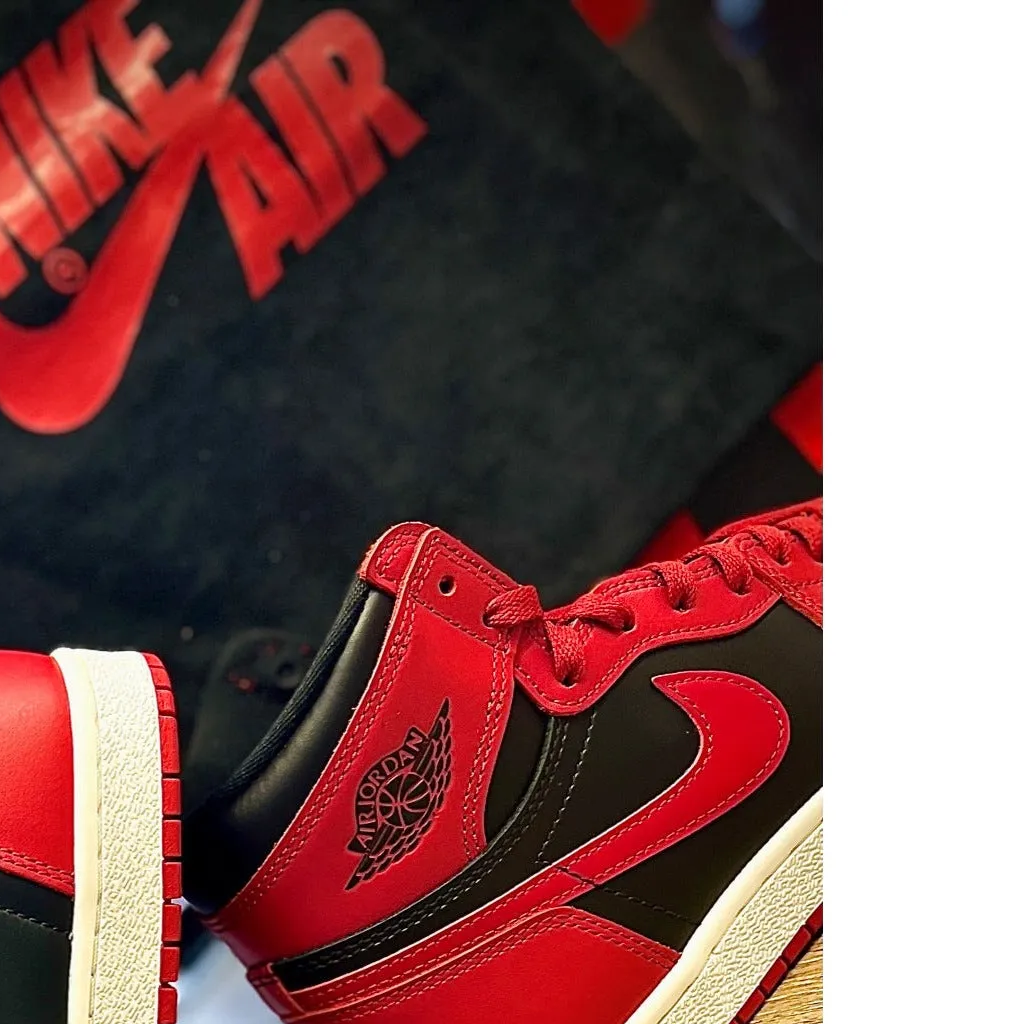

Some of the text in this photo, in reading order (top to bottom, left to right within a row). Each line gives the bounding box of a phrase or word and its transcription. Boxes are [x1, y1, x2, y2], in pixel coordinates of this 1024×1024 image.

[205, 9, 428, 299] AIR
[357, 731, 423, 848] AIR JORDAN
